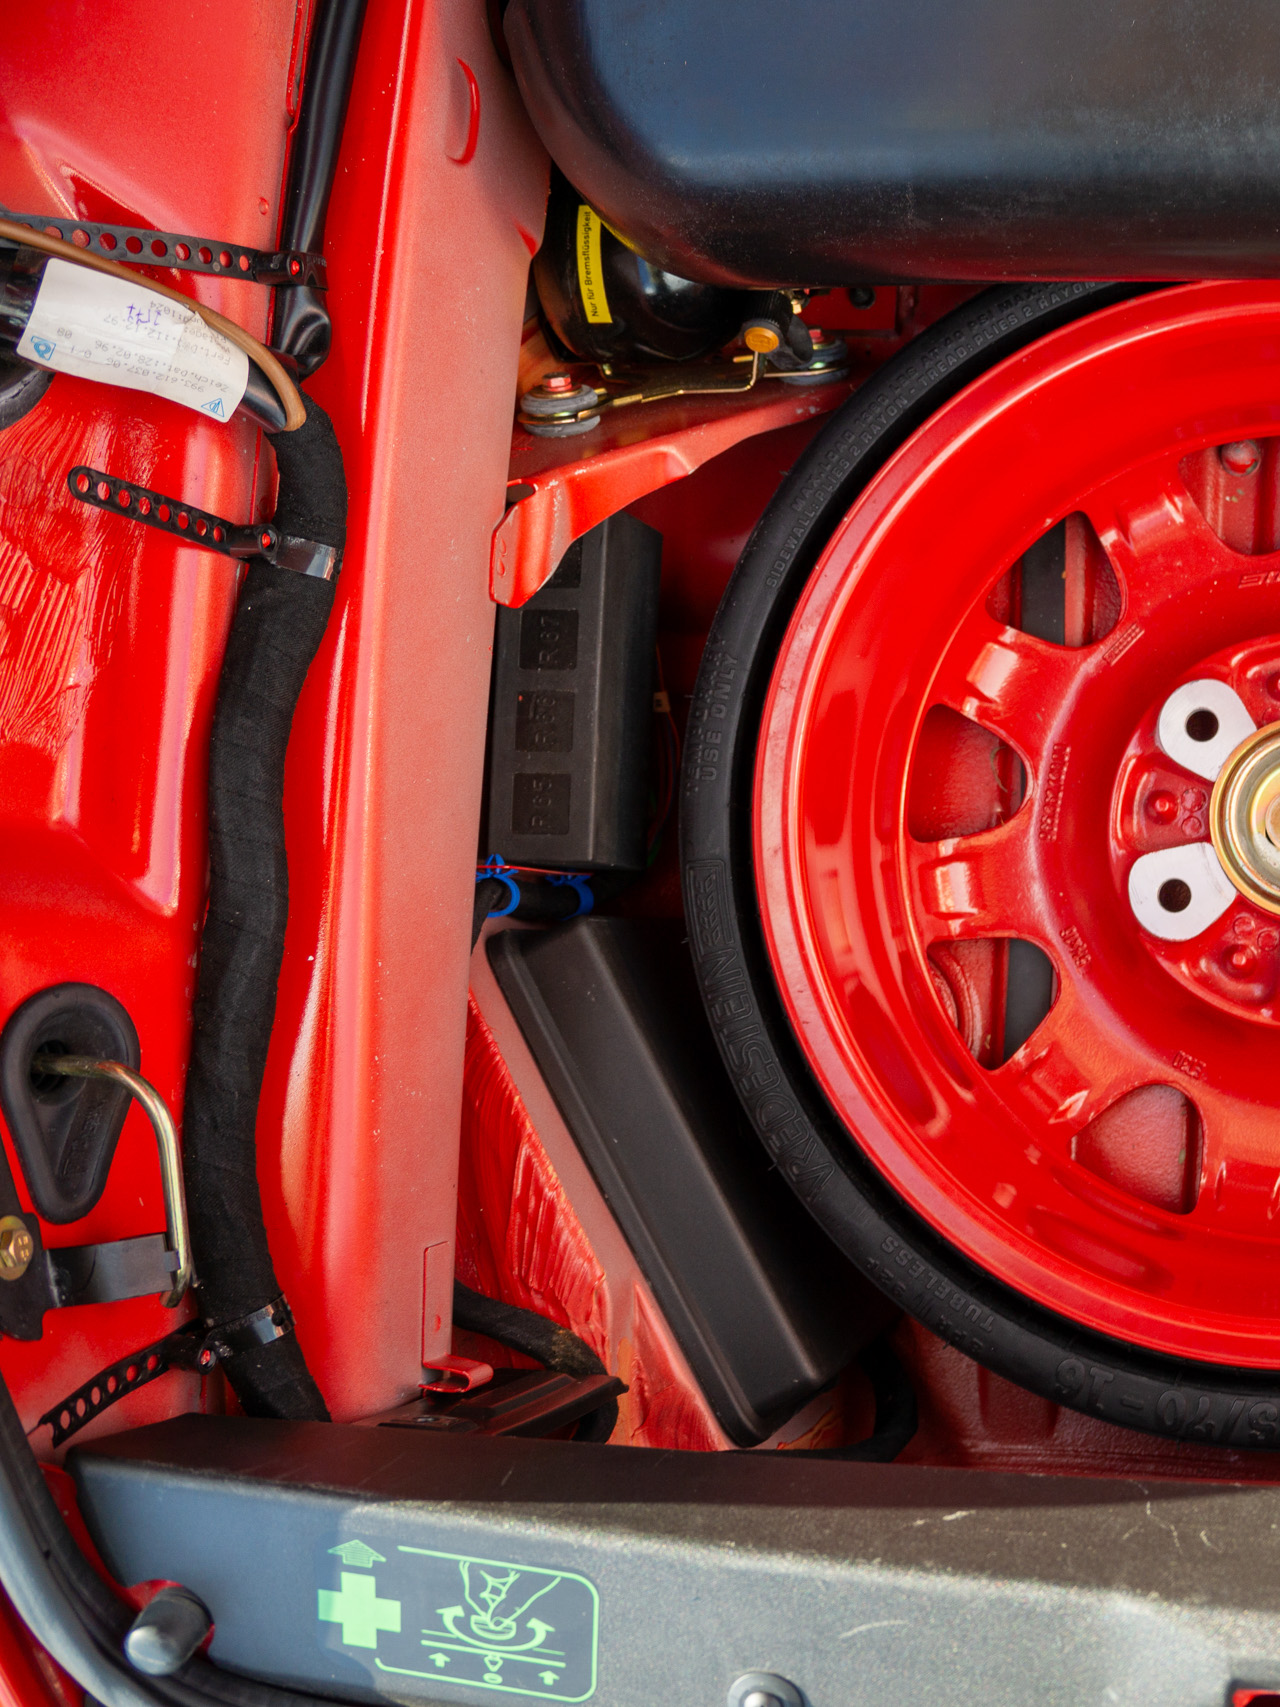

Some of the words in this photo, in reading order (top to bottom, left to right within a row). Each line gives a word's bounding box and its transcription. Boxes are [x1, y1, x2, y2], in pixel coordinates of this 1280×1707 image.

[579, 210, 594, 285] Bremsflüssigkeit
[587, 287, 595, 300] für
[590, 302, 599, 316] Nur
[763, 500, 821, 588] SIDEWALL:
[812, 455, 852, 502] PLIES
[846, 441, 863, 458] 2
[858, 393, 909, 444] RAYON
[971, 311, 1019, 347] PLIES
[1020, 303, 1034, 318] 2
[707, 651, 739, 719] ONLY
[698, 728, 722, 781] USE
[703, 945, 835, 1206] VREDESTEIN
[878, 1231, 998, 1335] TUBELESS
[1045, 1351, 1117, 1415] 16
